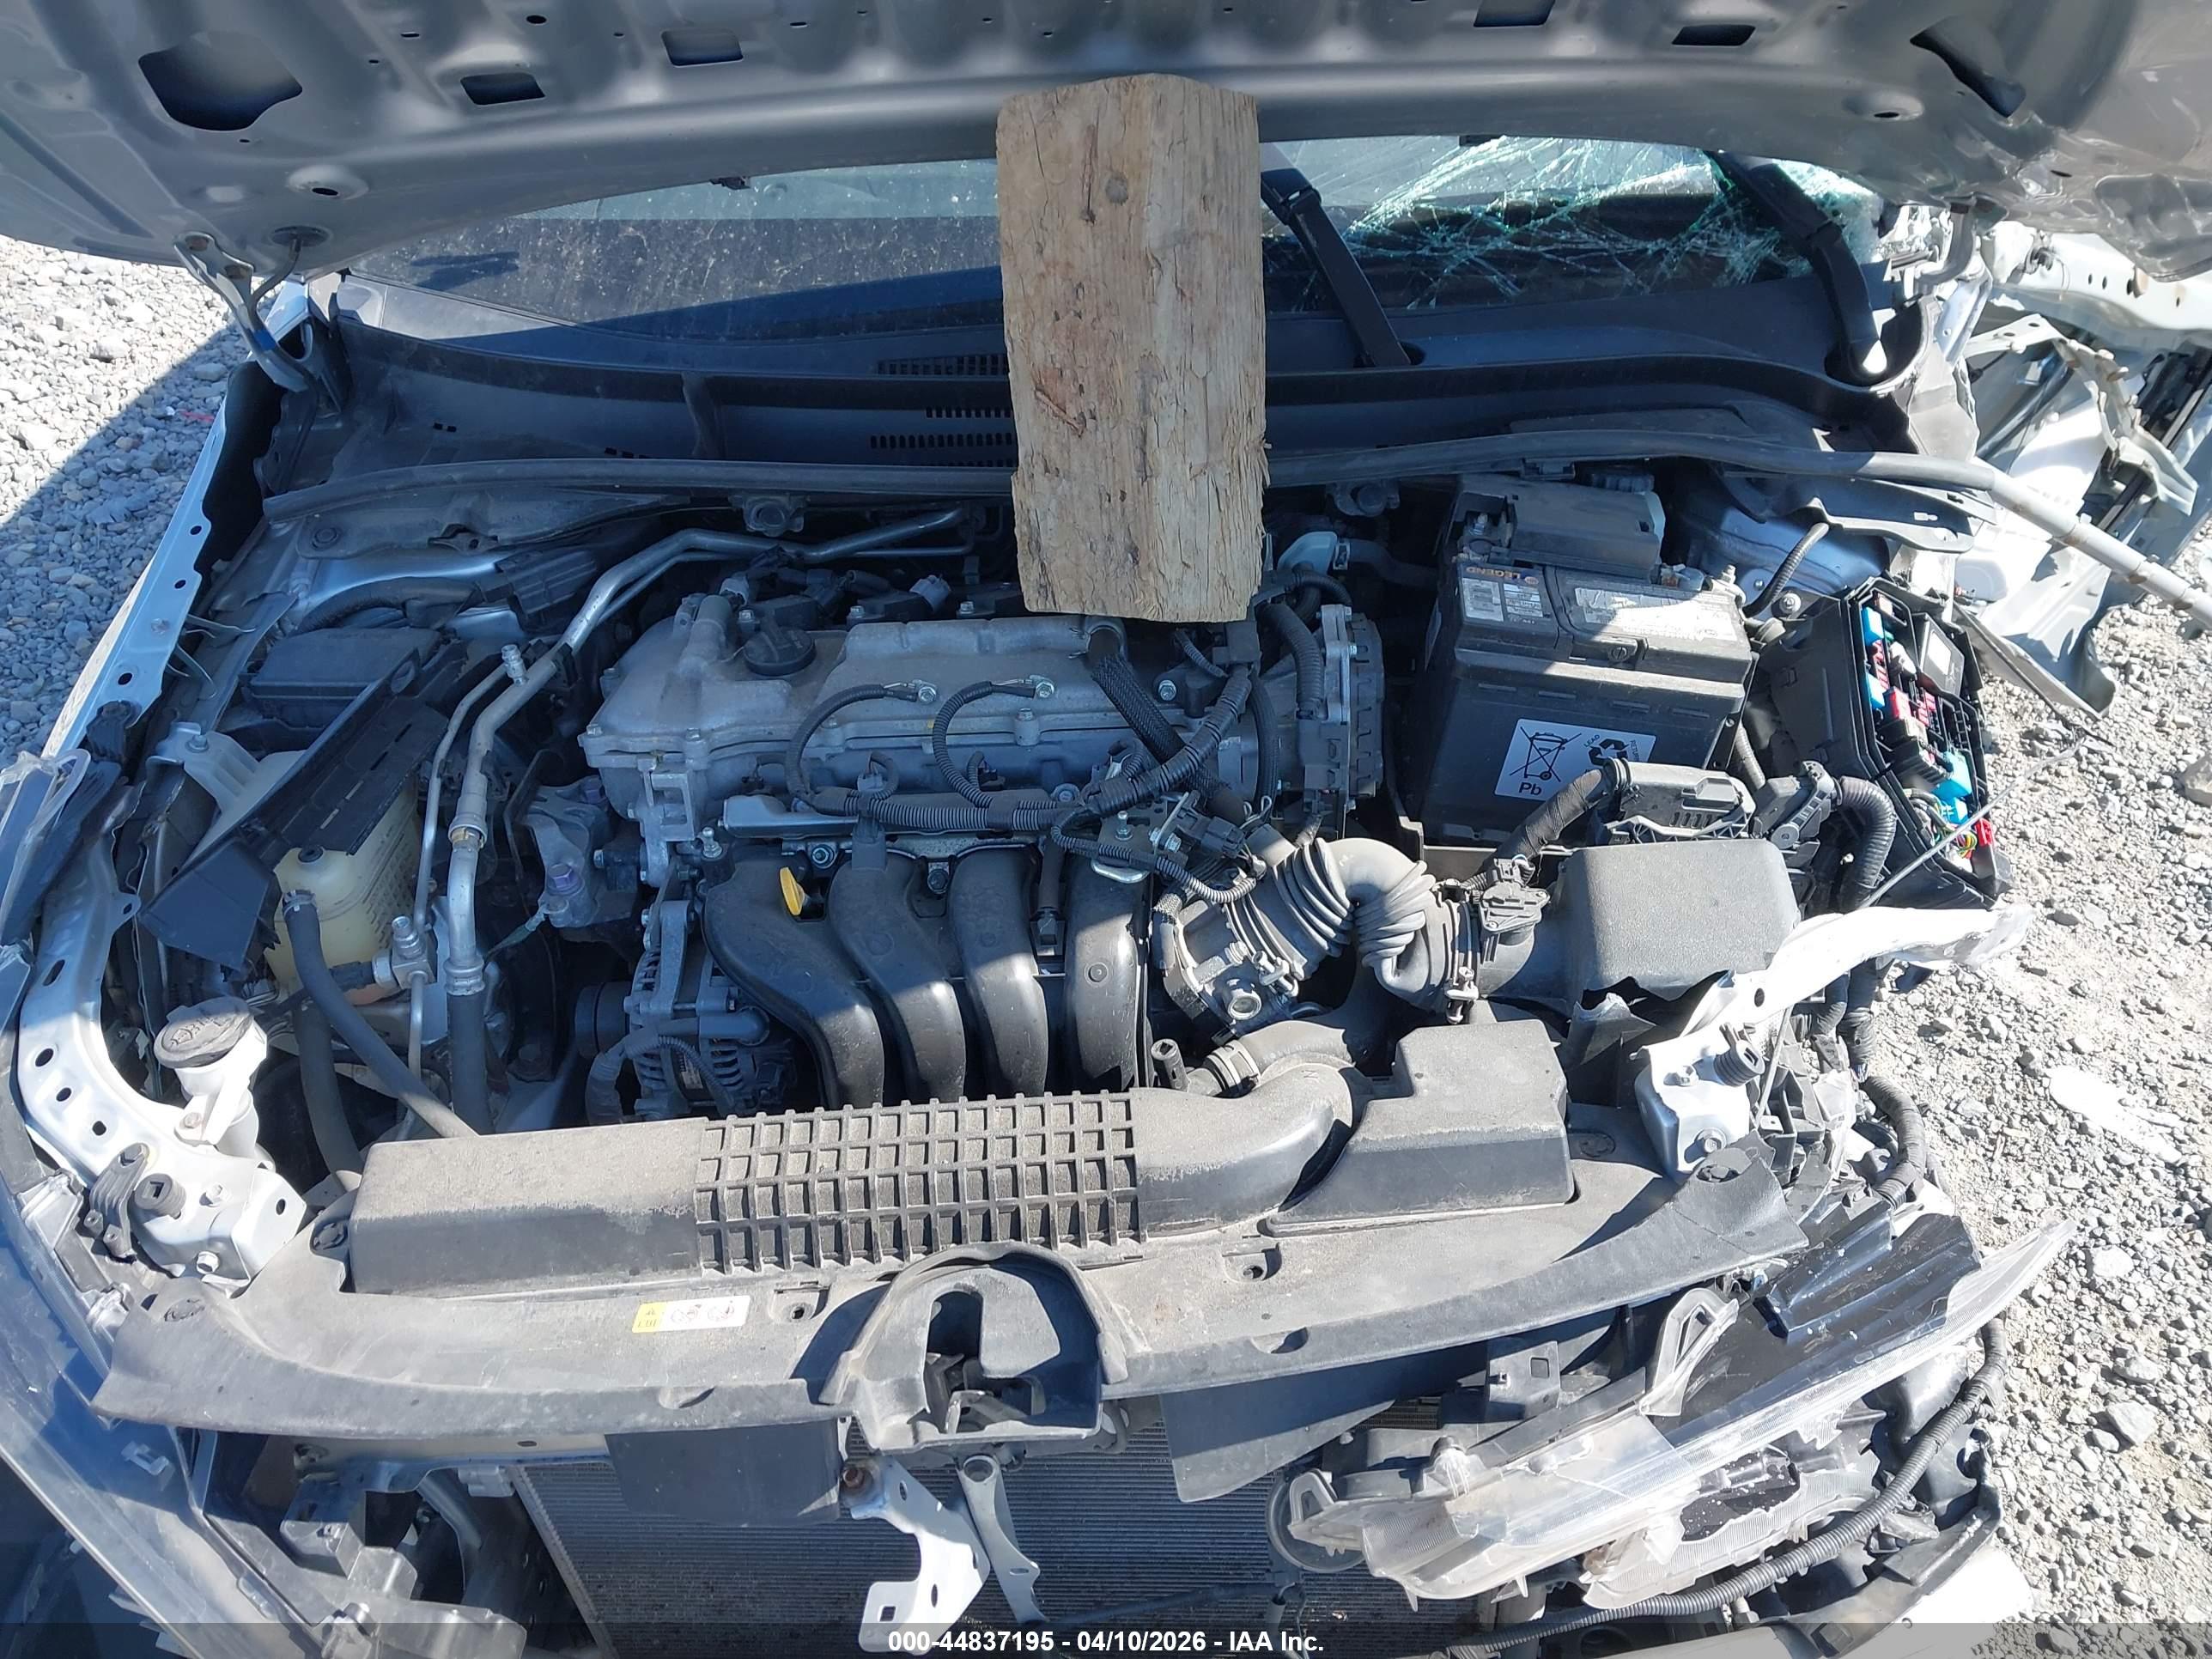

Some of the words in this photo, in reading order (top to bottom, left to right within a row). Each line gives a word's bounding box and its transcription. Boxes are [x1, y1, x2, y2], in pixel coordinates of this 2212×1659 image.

[1465, 566, 1521, 580] LEGEND
[1583, 734, 1601, 748] LEAD
[1518, 781, 1542, 796] Pb
